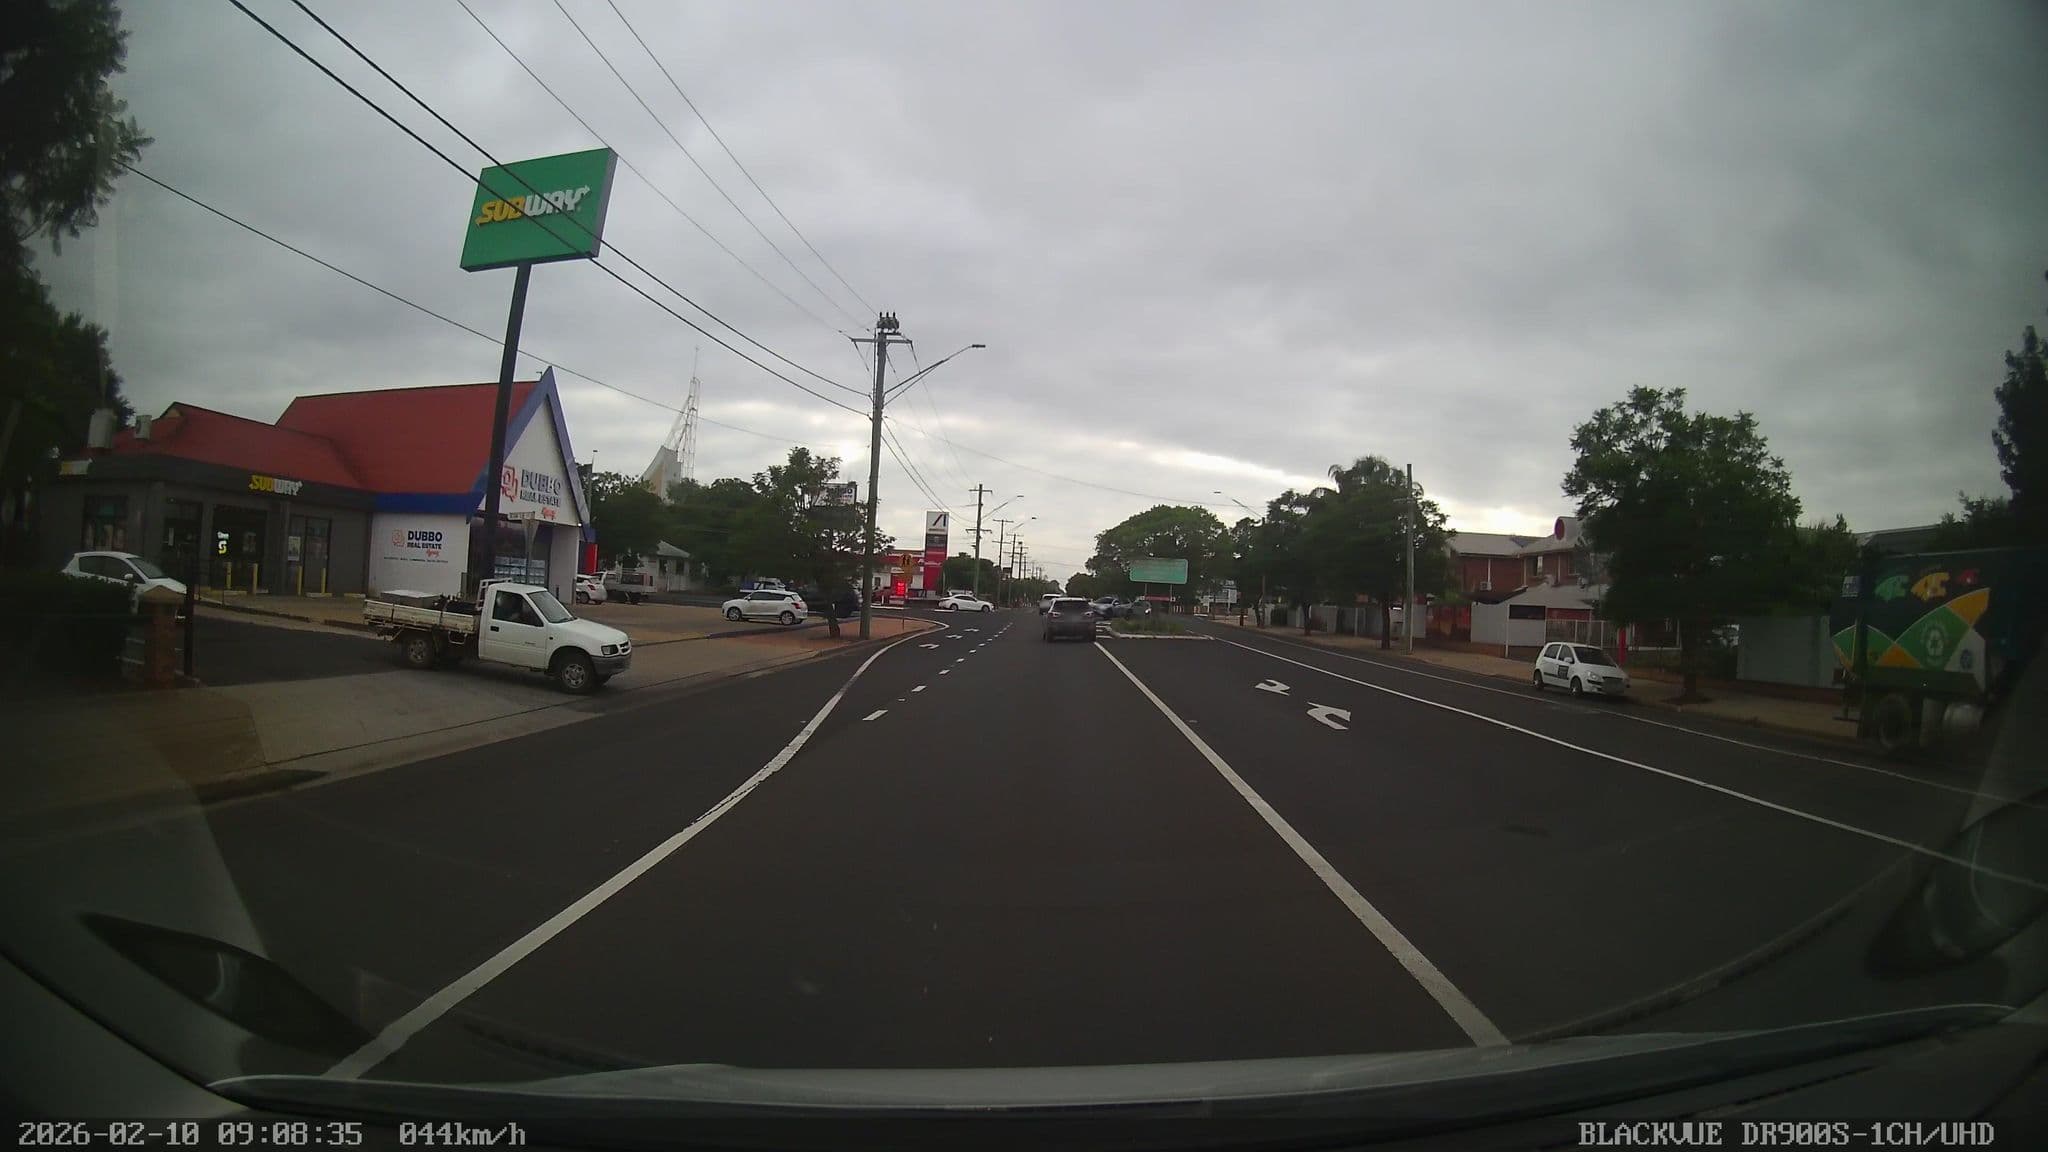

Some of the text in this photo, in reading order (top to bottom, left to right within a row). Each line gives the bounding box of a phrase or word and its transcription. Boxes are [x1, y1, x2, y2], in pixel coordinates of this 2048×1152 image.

[475, 185, 590, 227] SUBWAY
[249, 475, 302, 496] SUBWAY
[407, 530, 443, 542] DUBBO
